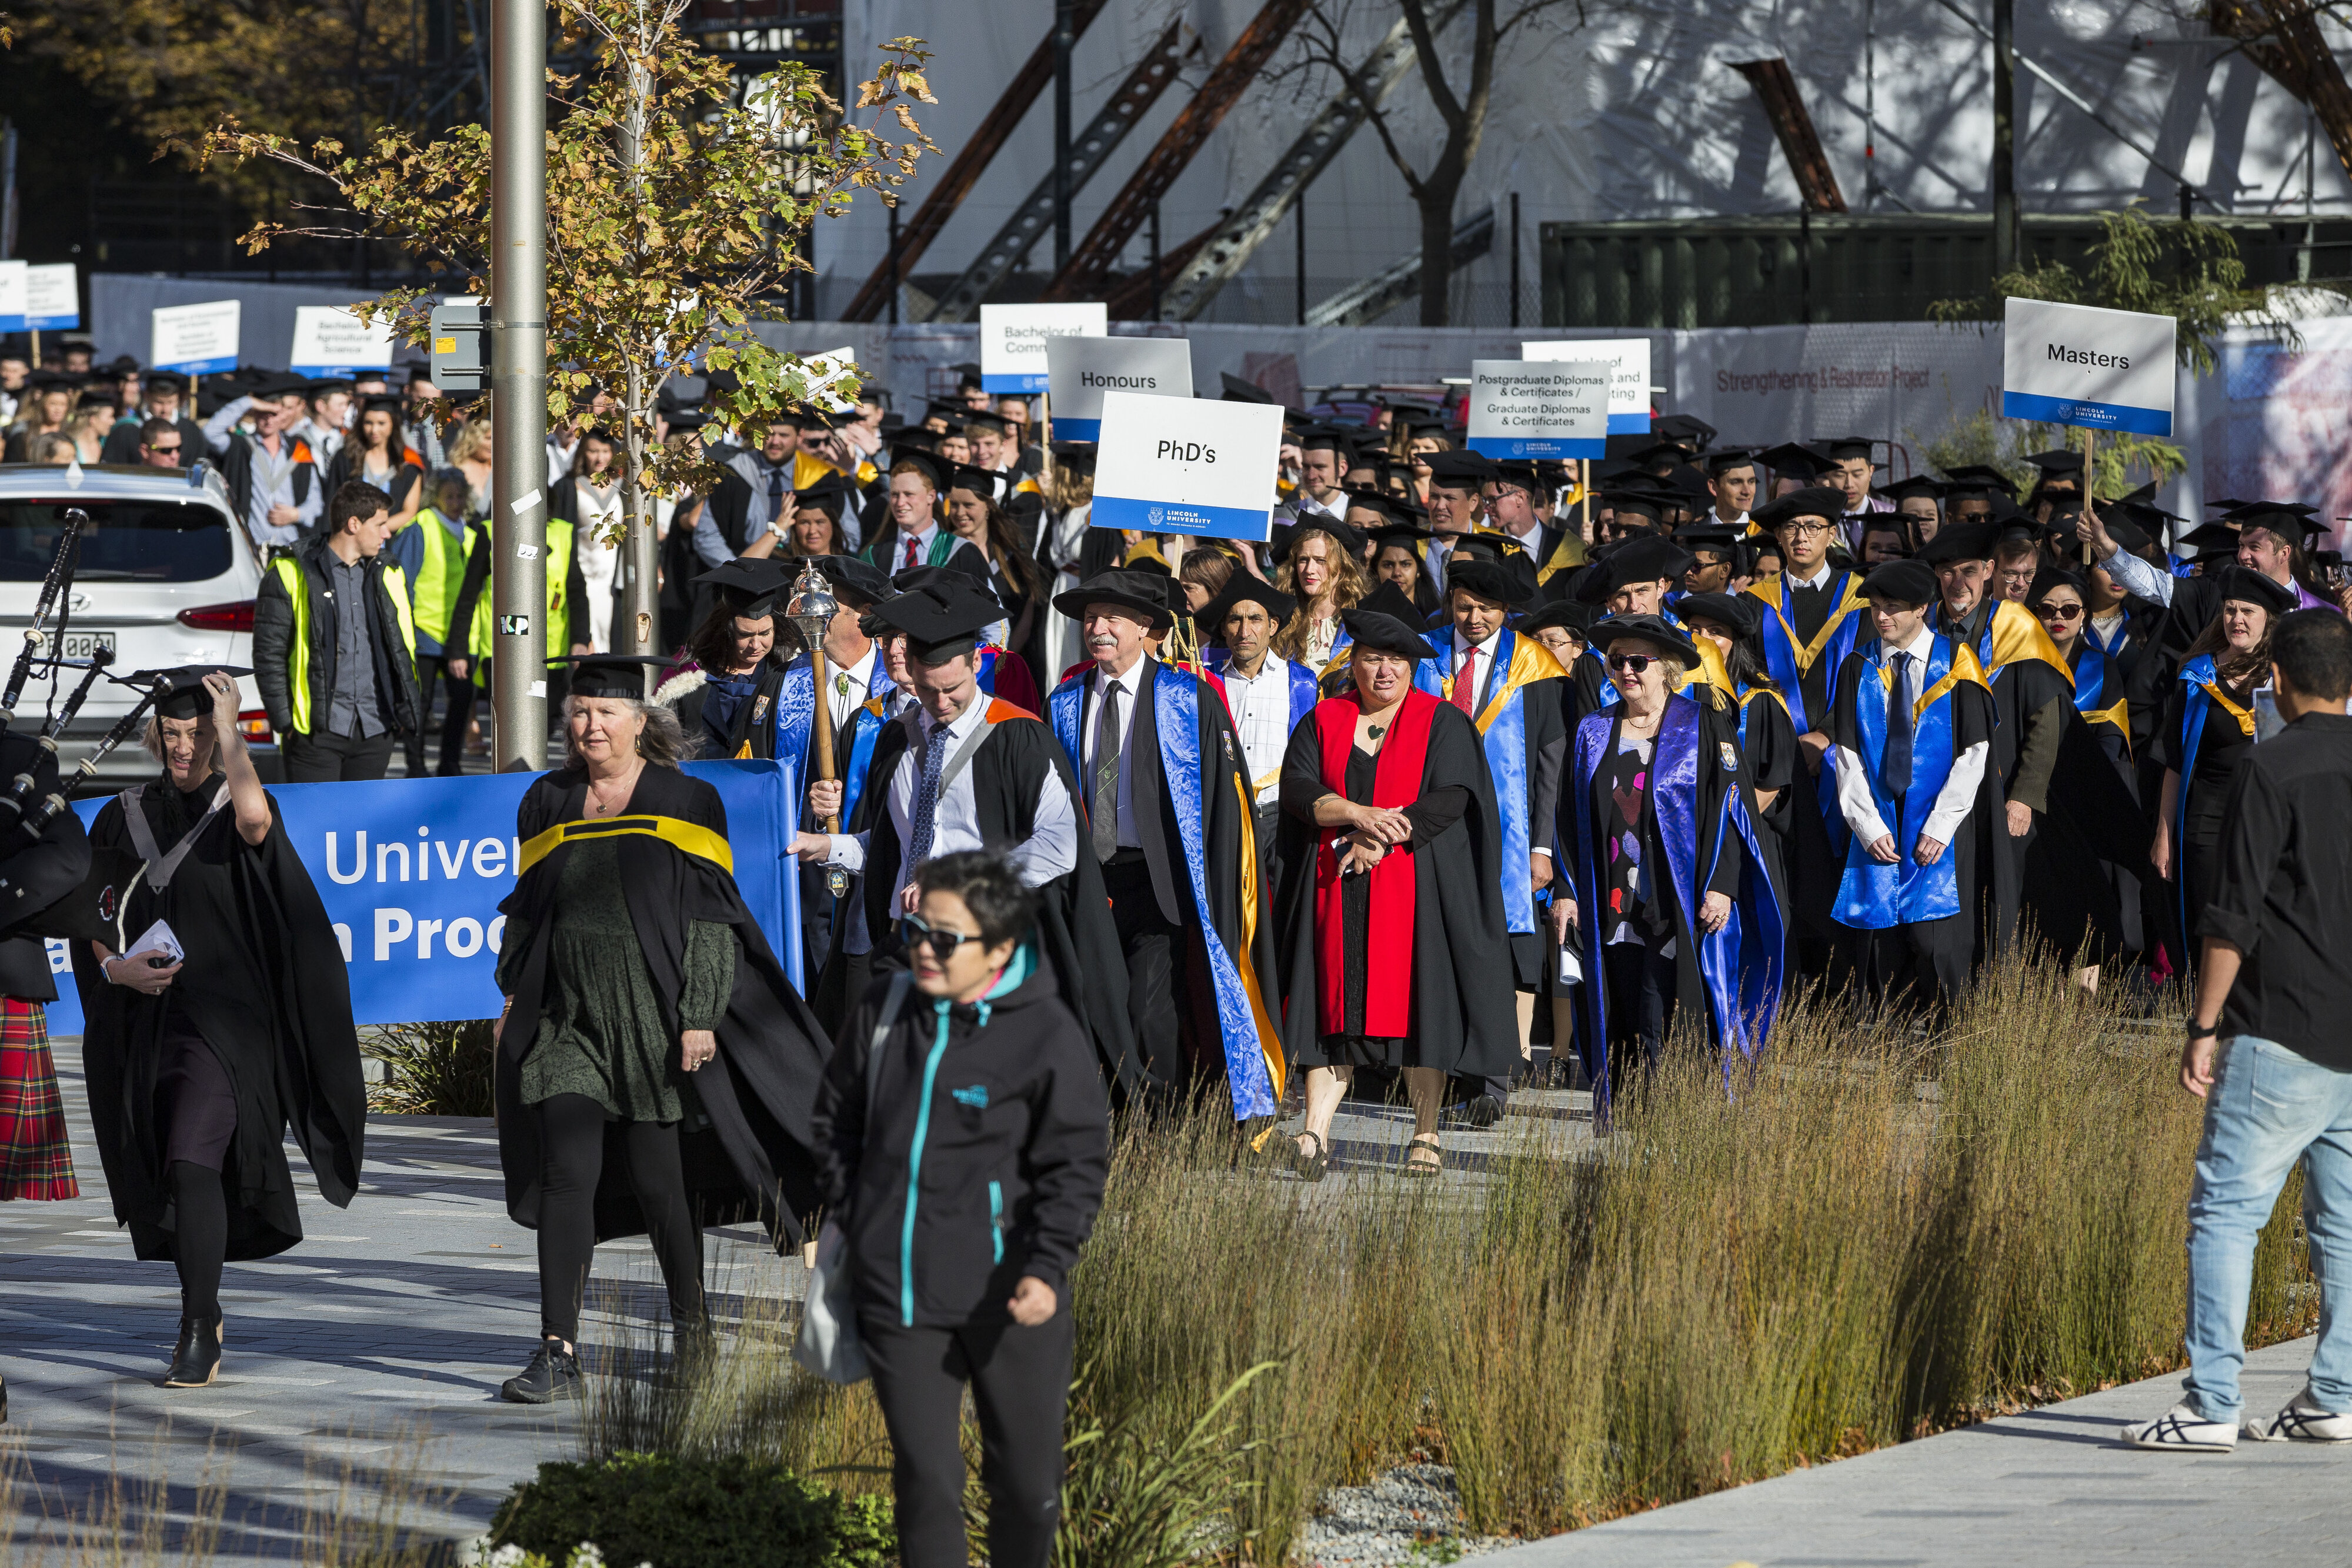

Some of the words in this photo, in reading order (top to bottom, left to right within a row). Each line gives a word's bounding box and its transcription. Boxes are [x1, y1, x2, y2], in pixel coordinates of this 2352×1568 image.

[1005, 326, 1064, 337] Bachelor
[1069, 324, 1083, 336] of
[1610, 356, 1622, 368] of
[2047, 343, 2130, 369] Masters
[1081, 371, 1156, 388] Honours
[1479, 374, 1552, 386] Postgraduate
[1553, 375, 1604, 386] Diplomas
[1617, 371, 1640, 383] and
[1716, 368, 1818, 396] Strengthening
[1819, 366, 1827, 388] &
[1891, 365, 1930, 392] Project
[1500, 387, 1507, 397] &
[1511, 387, 1573, 399] Certificates
[1575, 388, 1581, 398] /
[1487, 403, 1538, 413] Graduate
[1541, 404, 1591, 415] Diplomas
[1502, 416, 1509, 425] &
[1512, 416, 1575, 426] Certificates
[2076, 411, 2117, 421] UNIVERSITY
[1157, 440, 1216, 463] PhD's
[1167, 515, 1211, 525] UNIVERSITY
